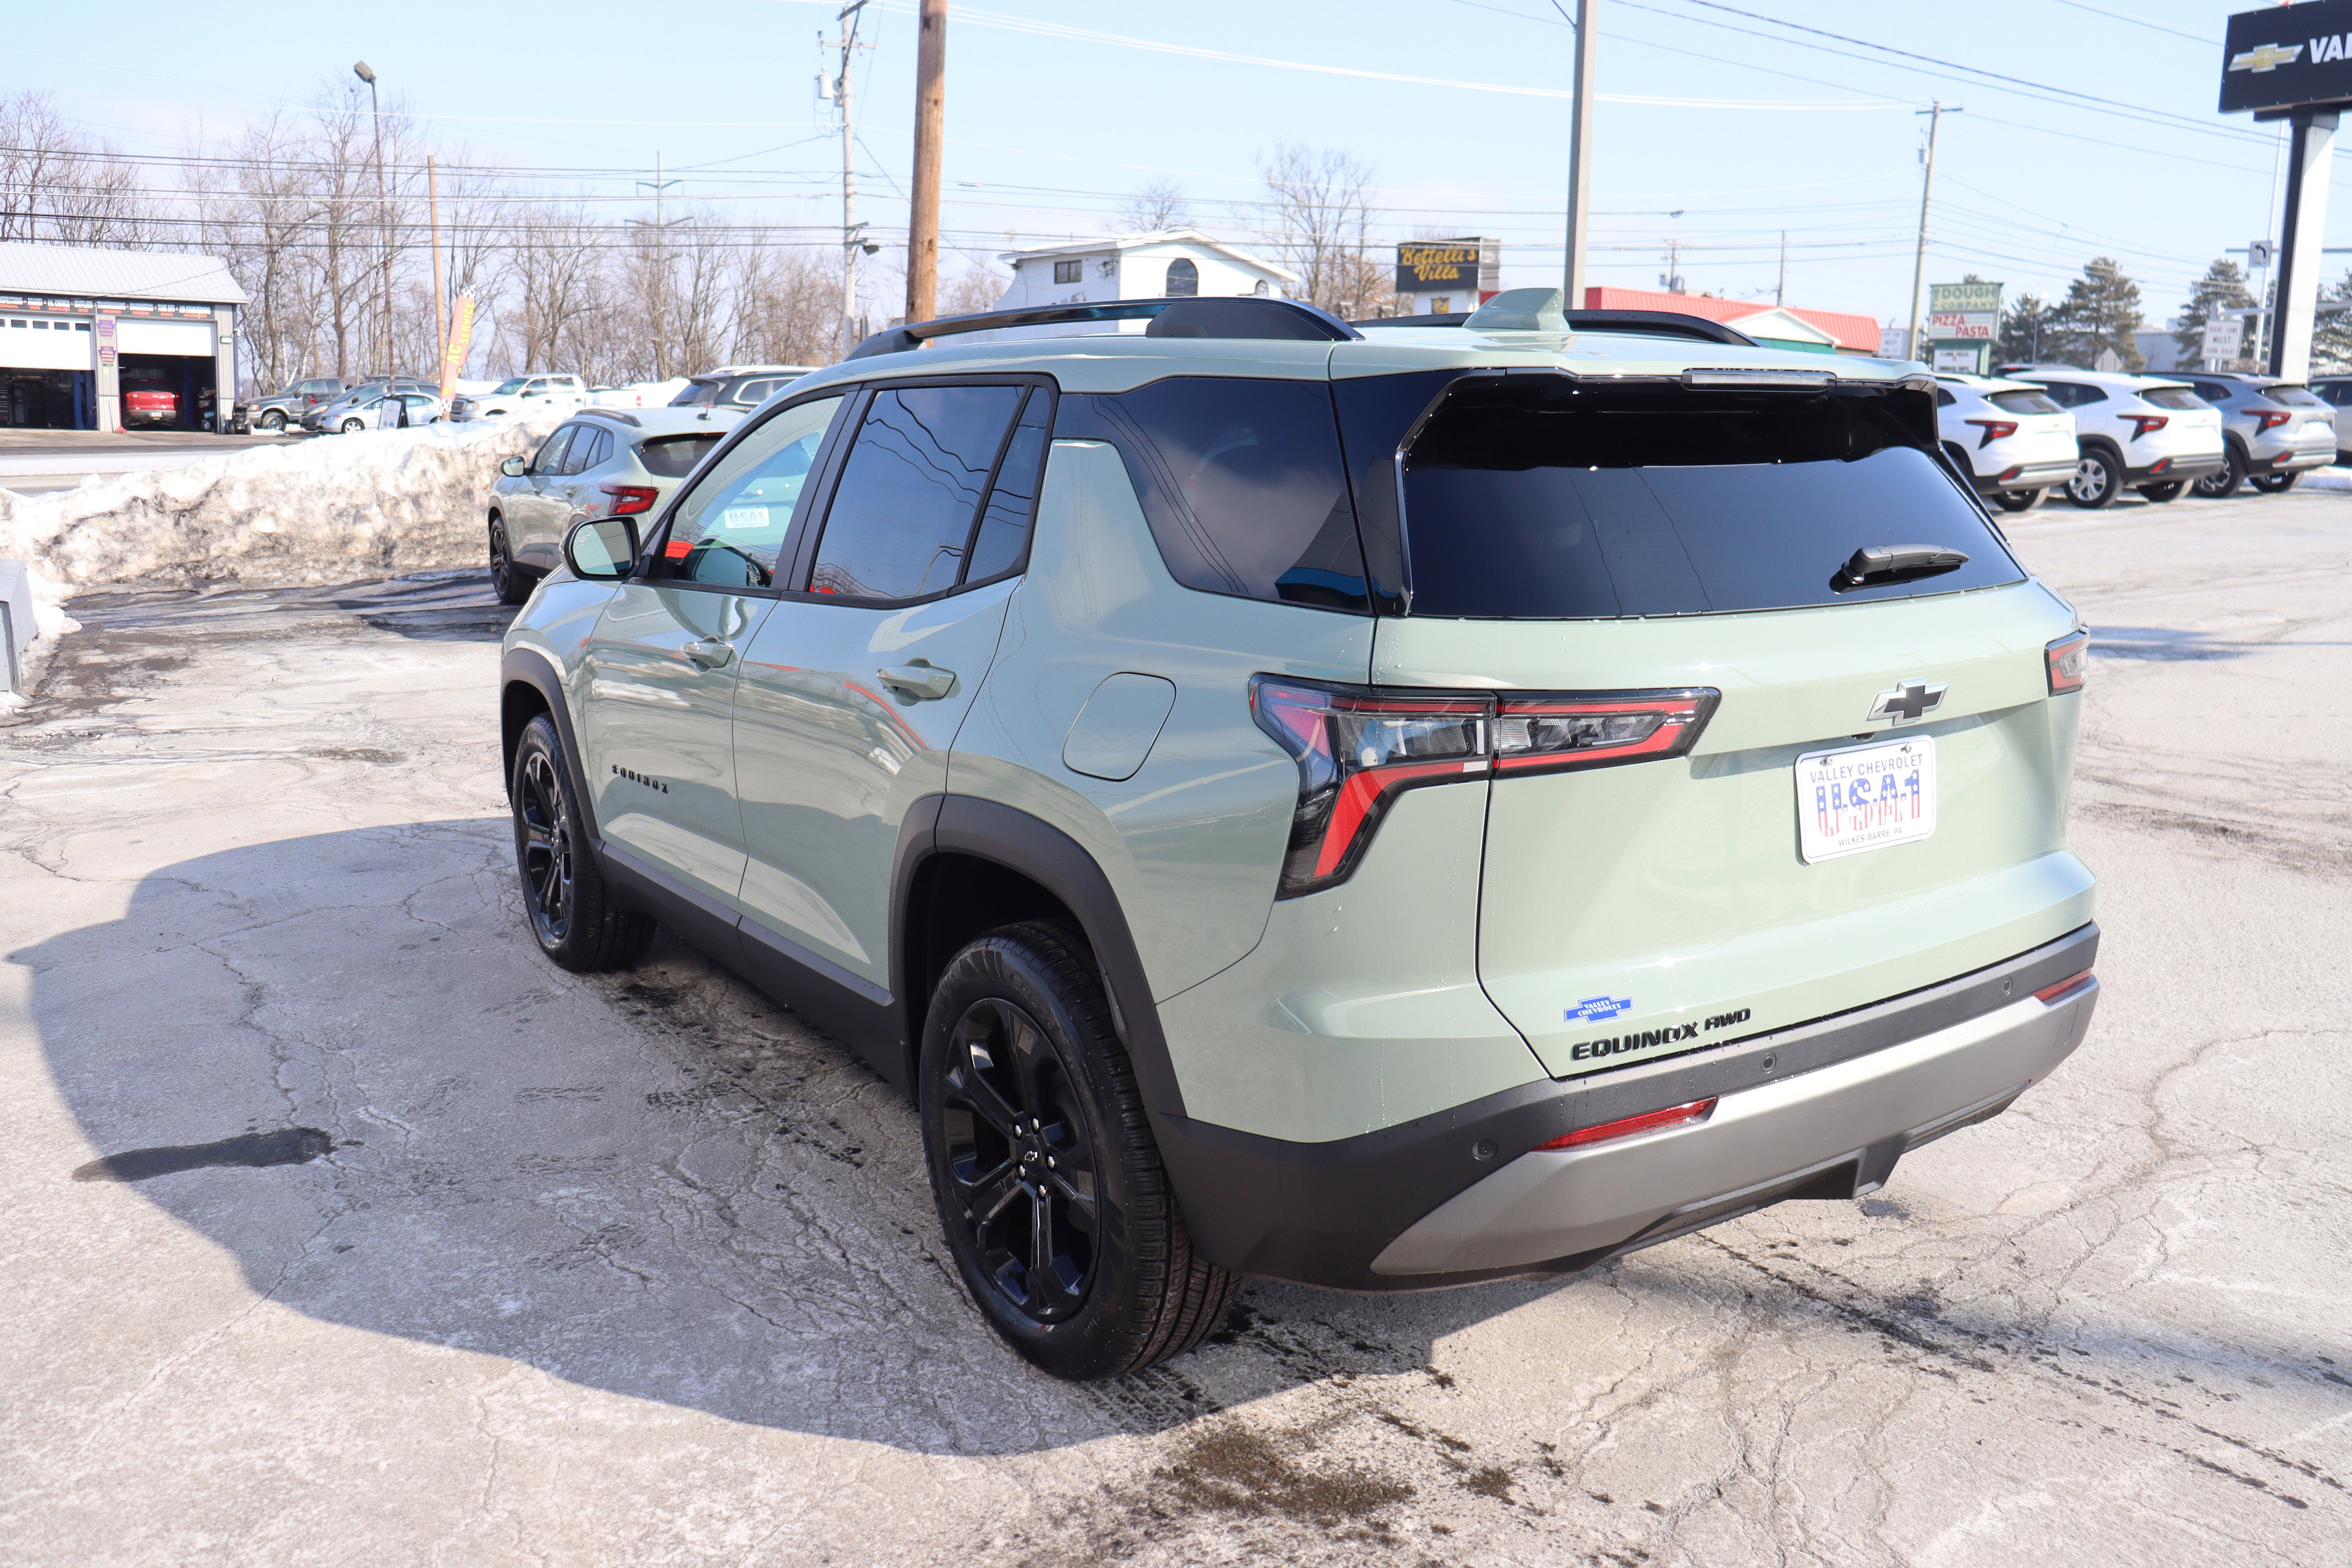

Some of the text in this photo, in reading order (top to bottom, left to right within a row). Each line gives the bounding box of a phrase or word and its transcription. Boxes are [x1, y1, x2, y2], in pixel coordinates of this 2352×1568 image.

[1414, 265, 1460, 282] Villa
[1942, 287, 1995, 299] DOUGH
[1941, 301, 1994, 310] COMPANY
[460, 301, 474, 345] SERVICE
[1932, 314, 1965, 326] PIZZA
[1956, 325, 1989, 337] PASTA
[2213, 335, 2231, 344] MUST
[446, 343, 462, 365] AC
[1810, 754, 1923, 783] VALLEY CHEVROLET
[612, 764, 668, 794] EQUINOX
[1578, 1003, 1621, 1016] CHEVROLET
[1584, 1000, 1610, 1009] VALLEY
[1572, 1007, 1751, 1060] EQUINOX AWD
